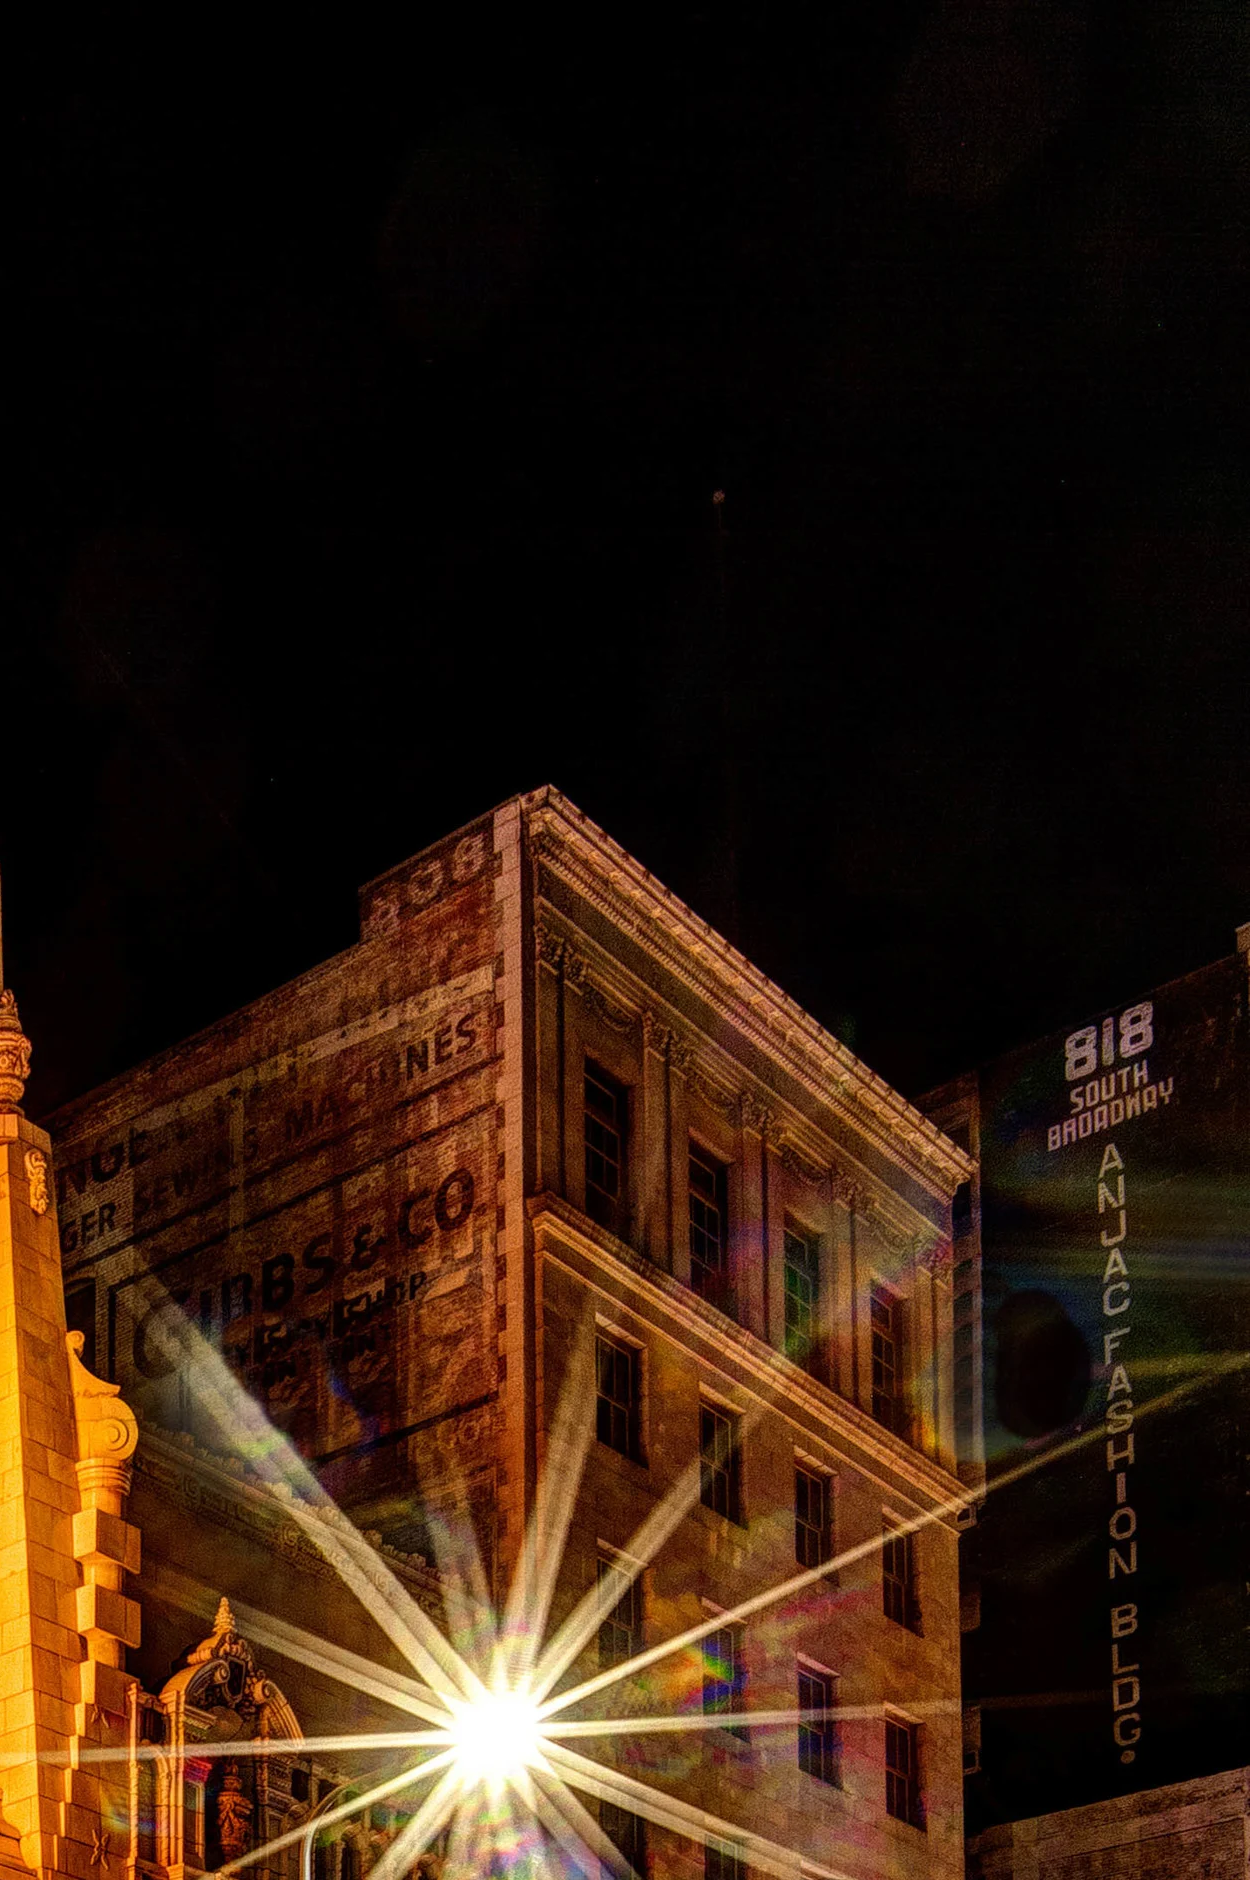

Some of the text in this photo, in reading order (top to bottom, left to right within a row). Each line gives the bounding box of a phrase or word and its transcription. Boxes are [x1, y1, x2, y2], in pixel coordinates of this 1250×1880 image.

[1065, 1000, 1154, 1081] 818
[1048, 1076, 1175, 1151] BROADWAY
[1070, 1059, 1149, 1114] SOUTH
[1099, 1143, 1131, 1317] ANJAC
[1103, 1327, 1137, 1579] FASHION
